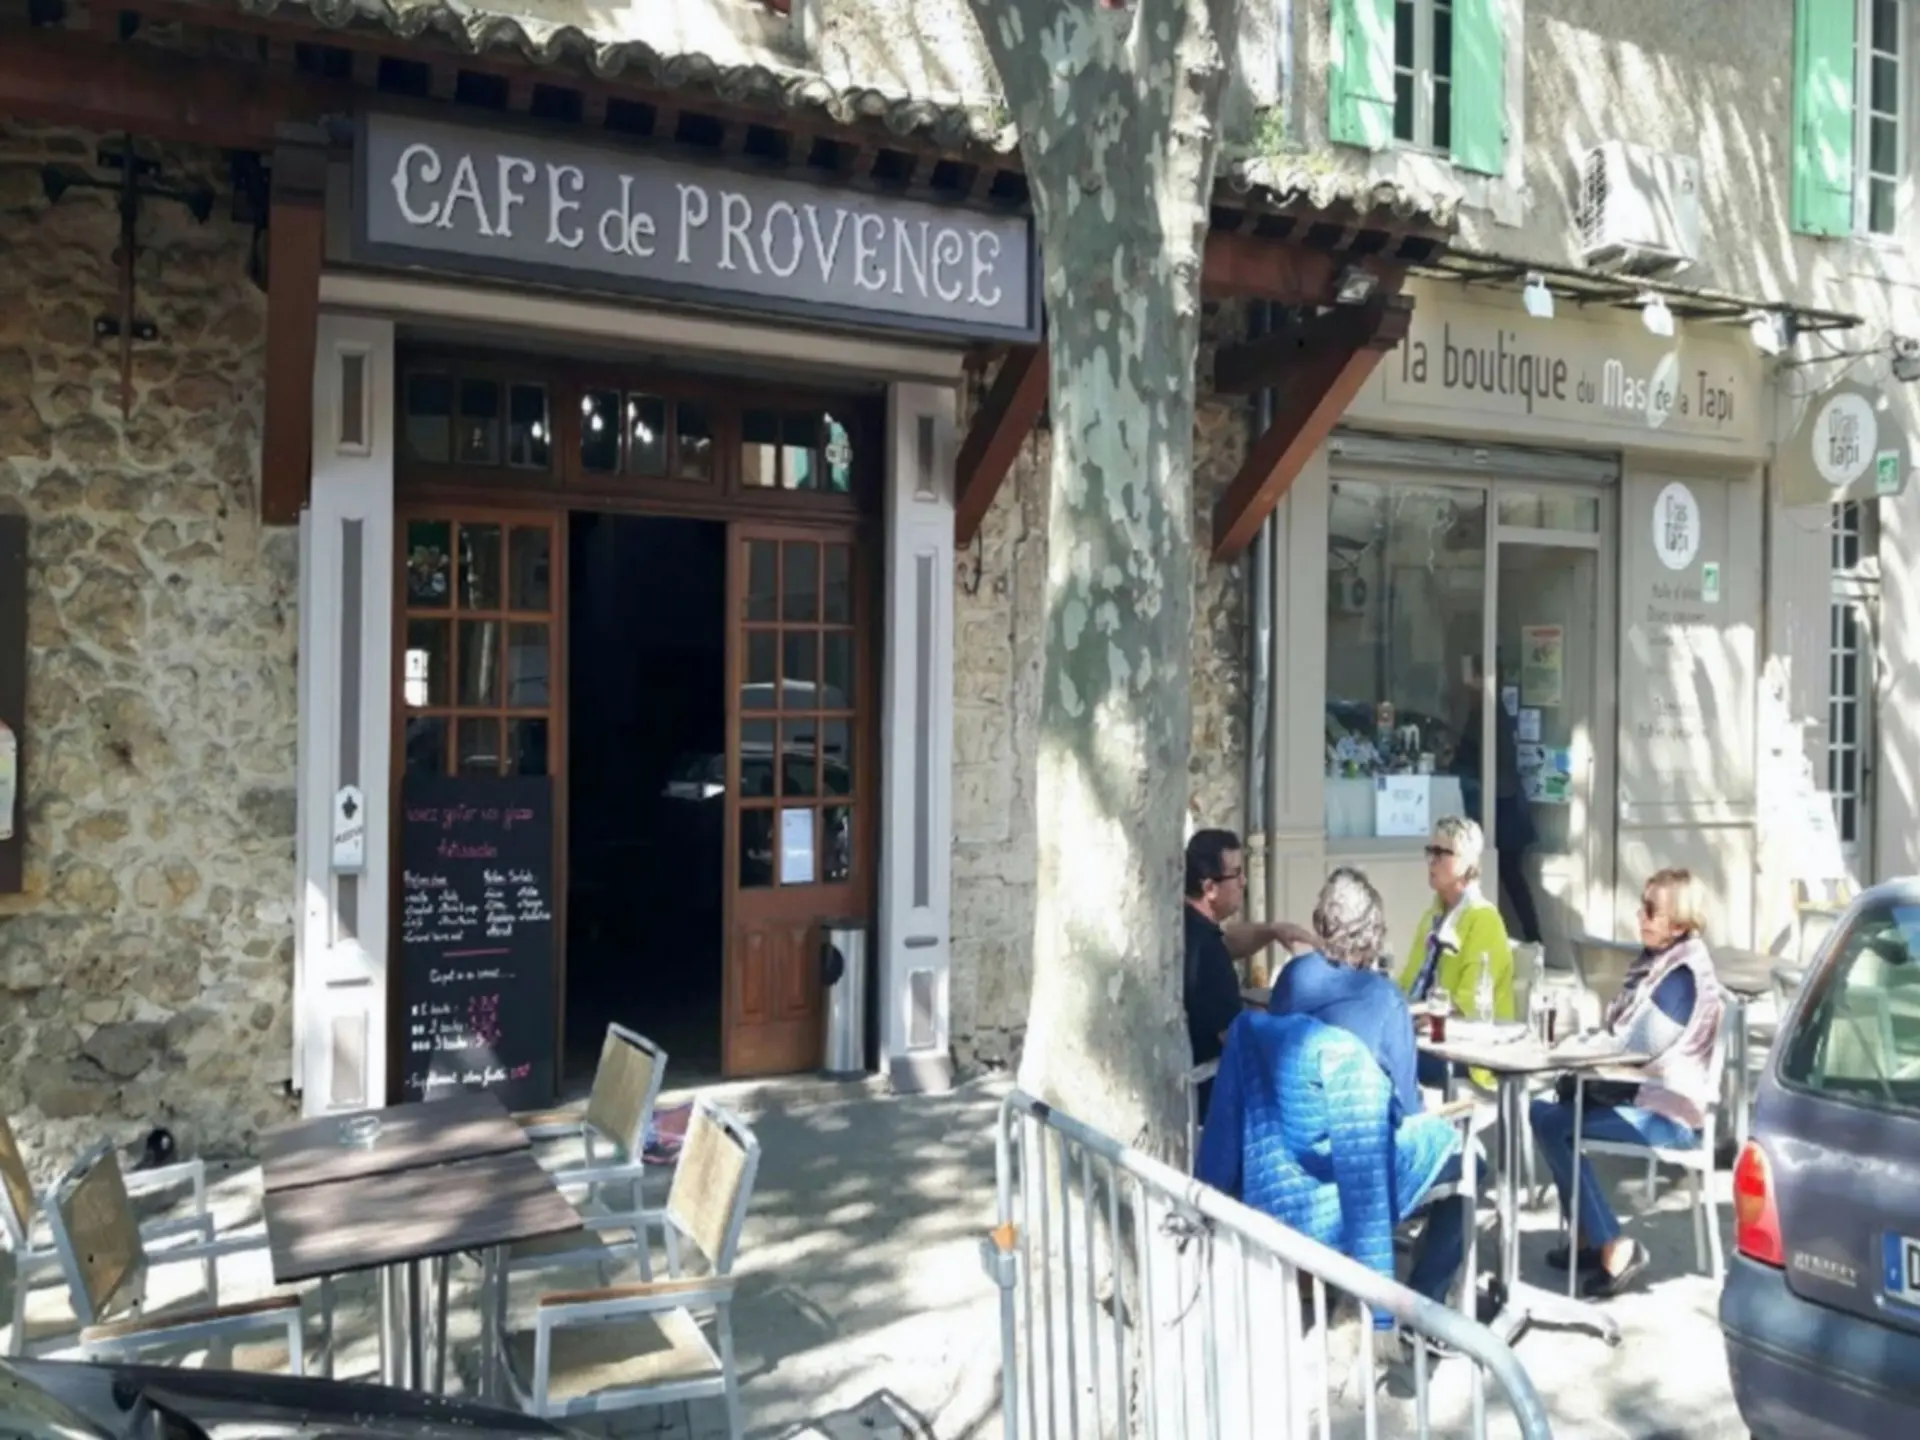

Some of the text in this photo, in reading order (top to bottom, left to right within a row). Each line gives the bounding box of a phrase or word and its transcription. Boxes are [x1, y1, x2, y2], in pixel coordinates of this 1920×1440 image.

[391, 142, 1002, 306] CAFE de PROVENCE
[1402, 335, 1428, 384] la
[1443, 320, 1568, 415] boutique
[1576, 368, 1596, 404] du
[1602, 357, 1647, 410] Mas
[1697, 369, 1734, 430] Tapi
[1829, 436, 1860, 472] Tapi
